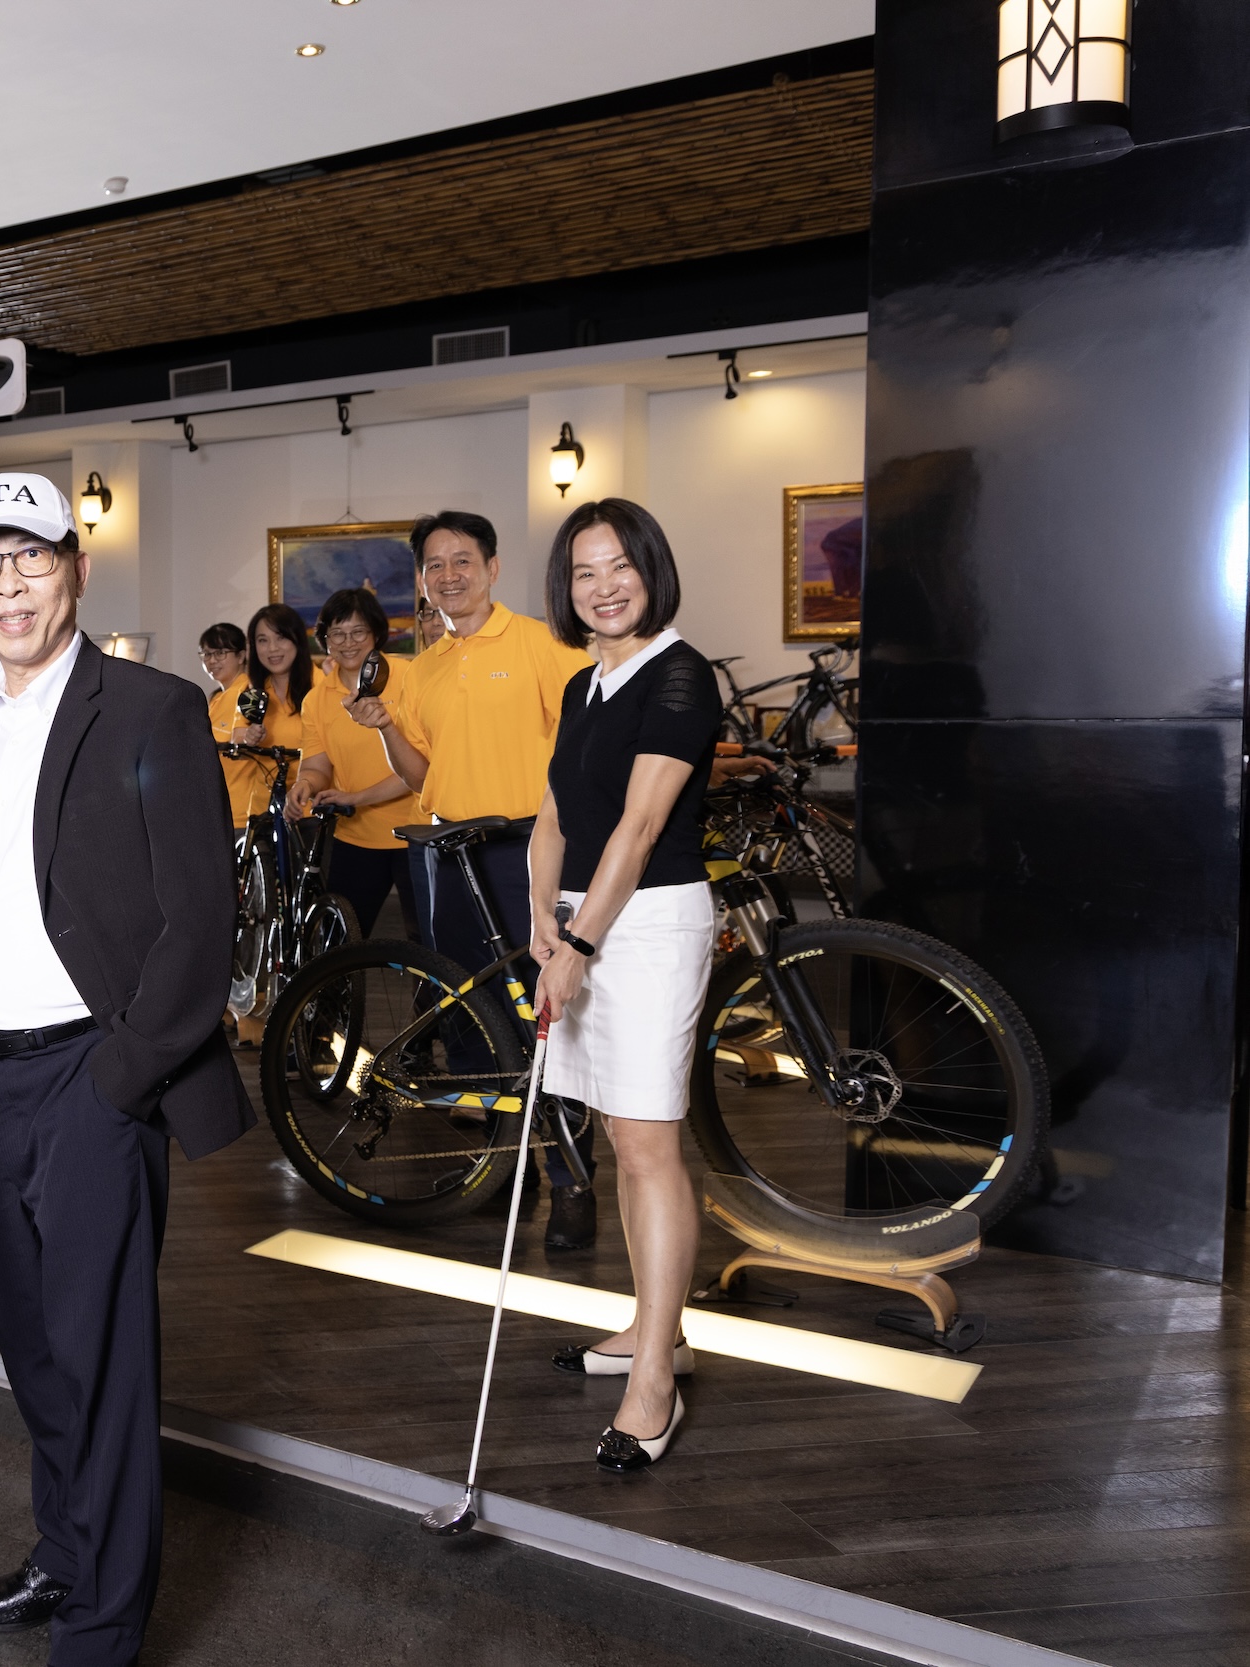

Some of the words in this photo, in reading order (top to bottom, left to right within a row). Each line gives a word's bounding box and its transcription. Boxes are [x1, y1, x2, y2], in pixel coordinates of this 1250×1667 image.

[809, 853, 846, 919] VOLAN
[285, 1111, 317, 1163] VOLANDO
[881, 1210, 953, 1235] VOLANDO
